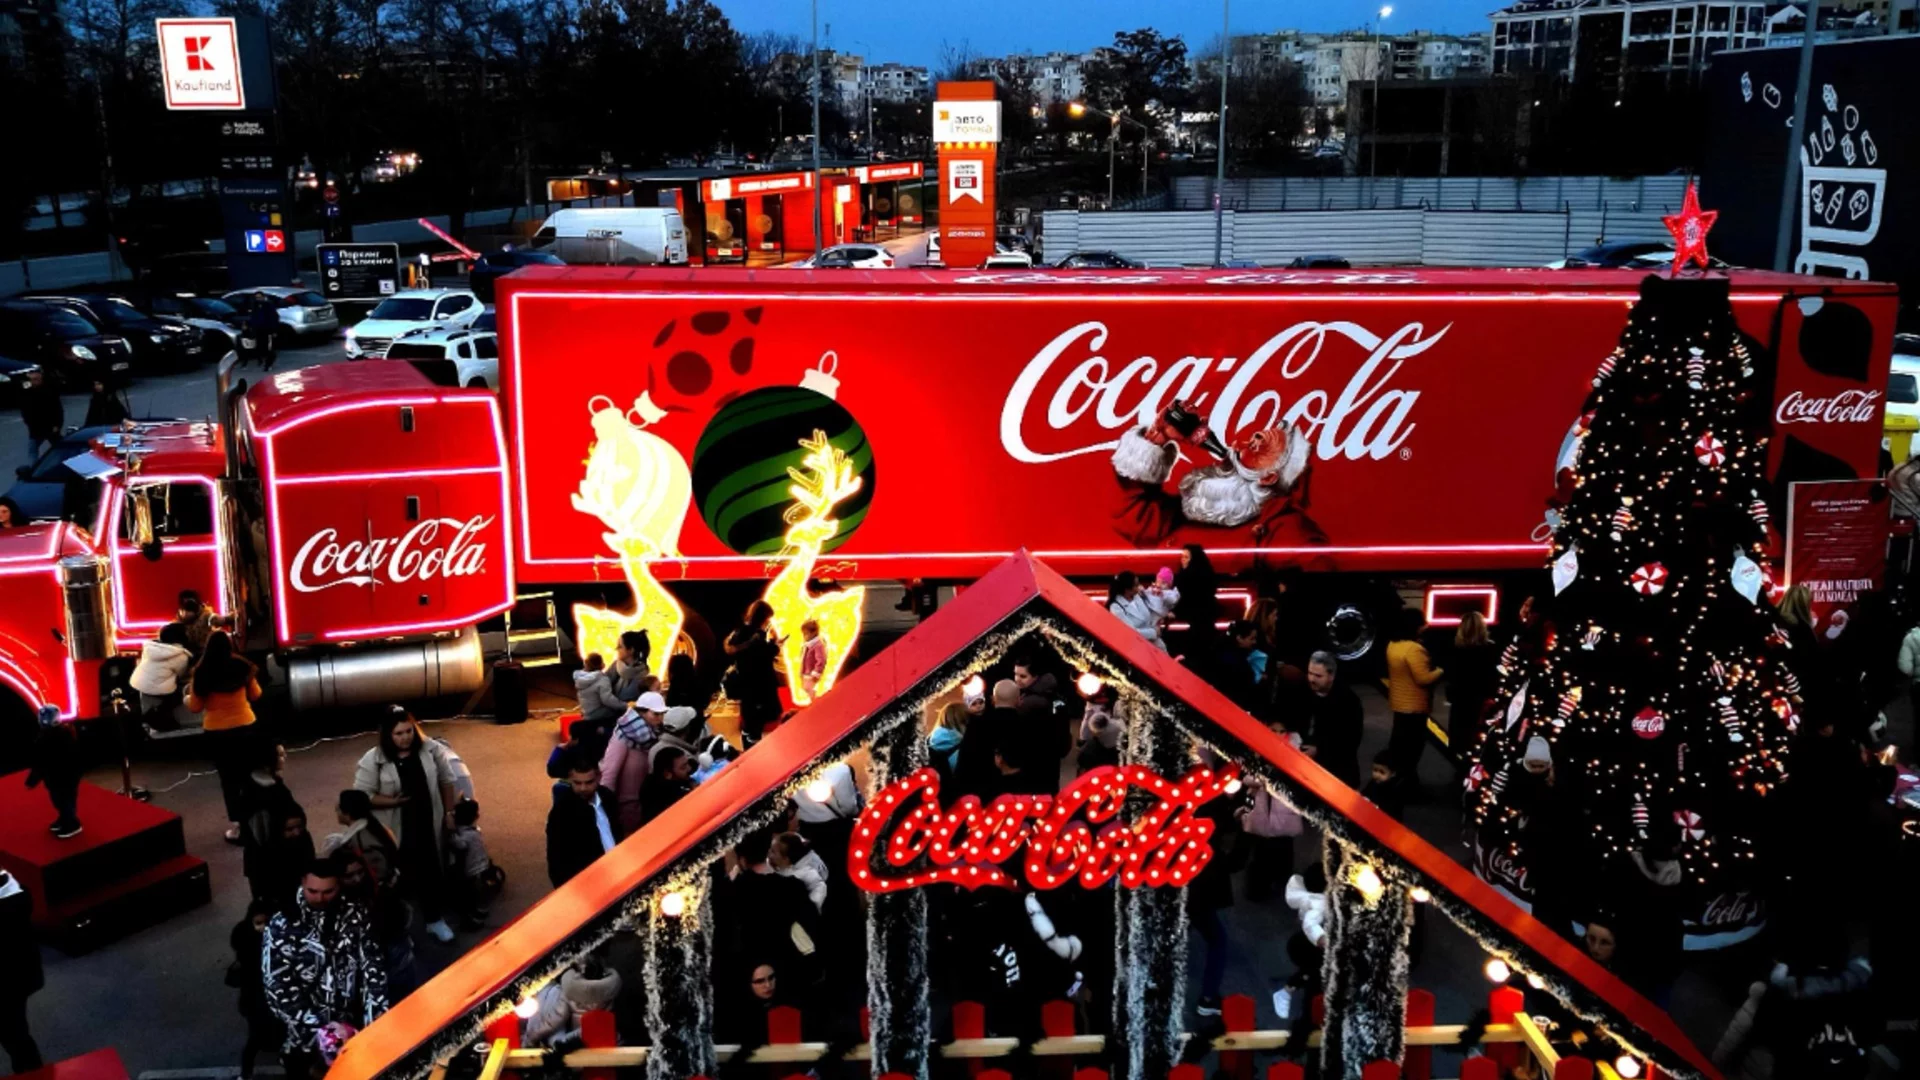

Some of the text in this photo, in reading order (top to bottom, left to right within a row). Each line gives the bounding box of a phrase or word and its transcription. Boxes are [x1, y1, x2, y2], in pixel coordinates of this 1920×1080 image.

[175, 79, 232, 91] Kaufland
[955, 115, 984, 124] авто
[1000, 321, 1453, 464] Coca-Cola
[1776, 390, 1883, 424] Coca-Cola
[289, 515, 496, 593] Coca-Cola
[847, 765, 1239, 892] Coca-Cola
